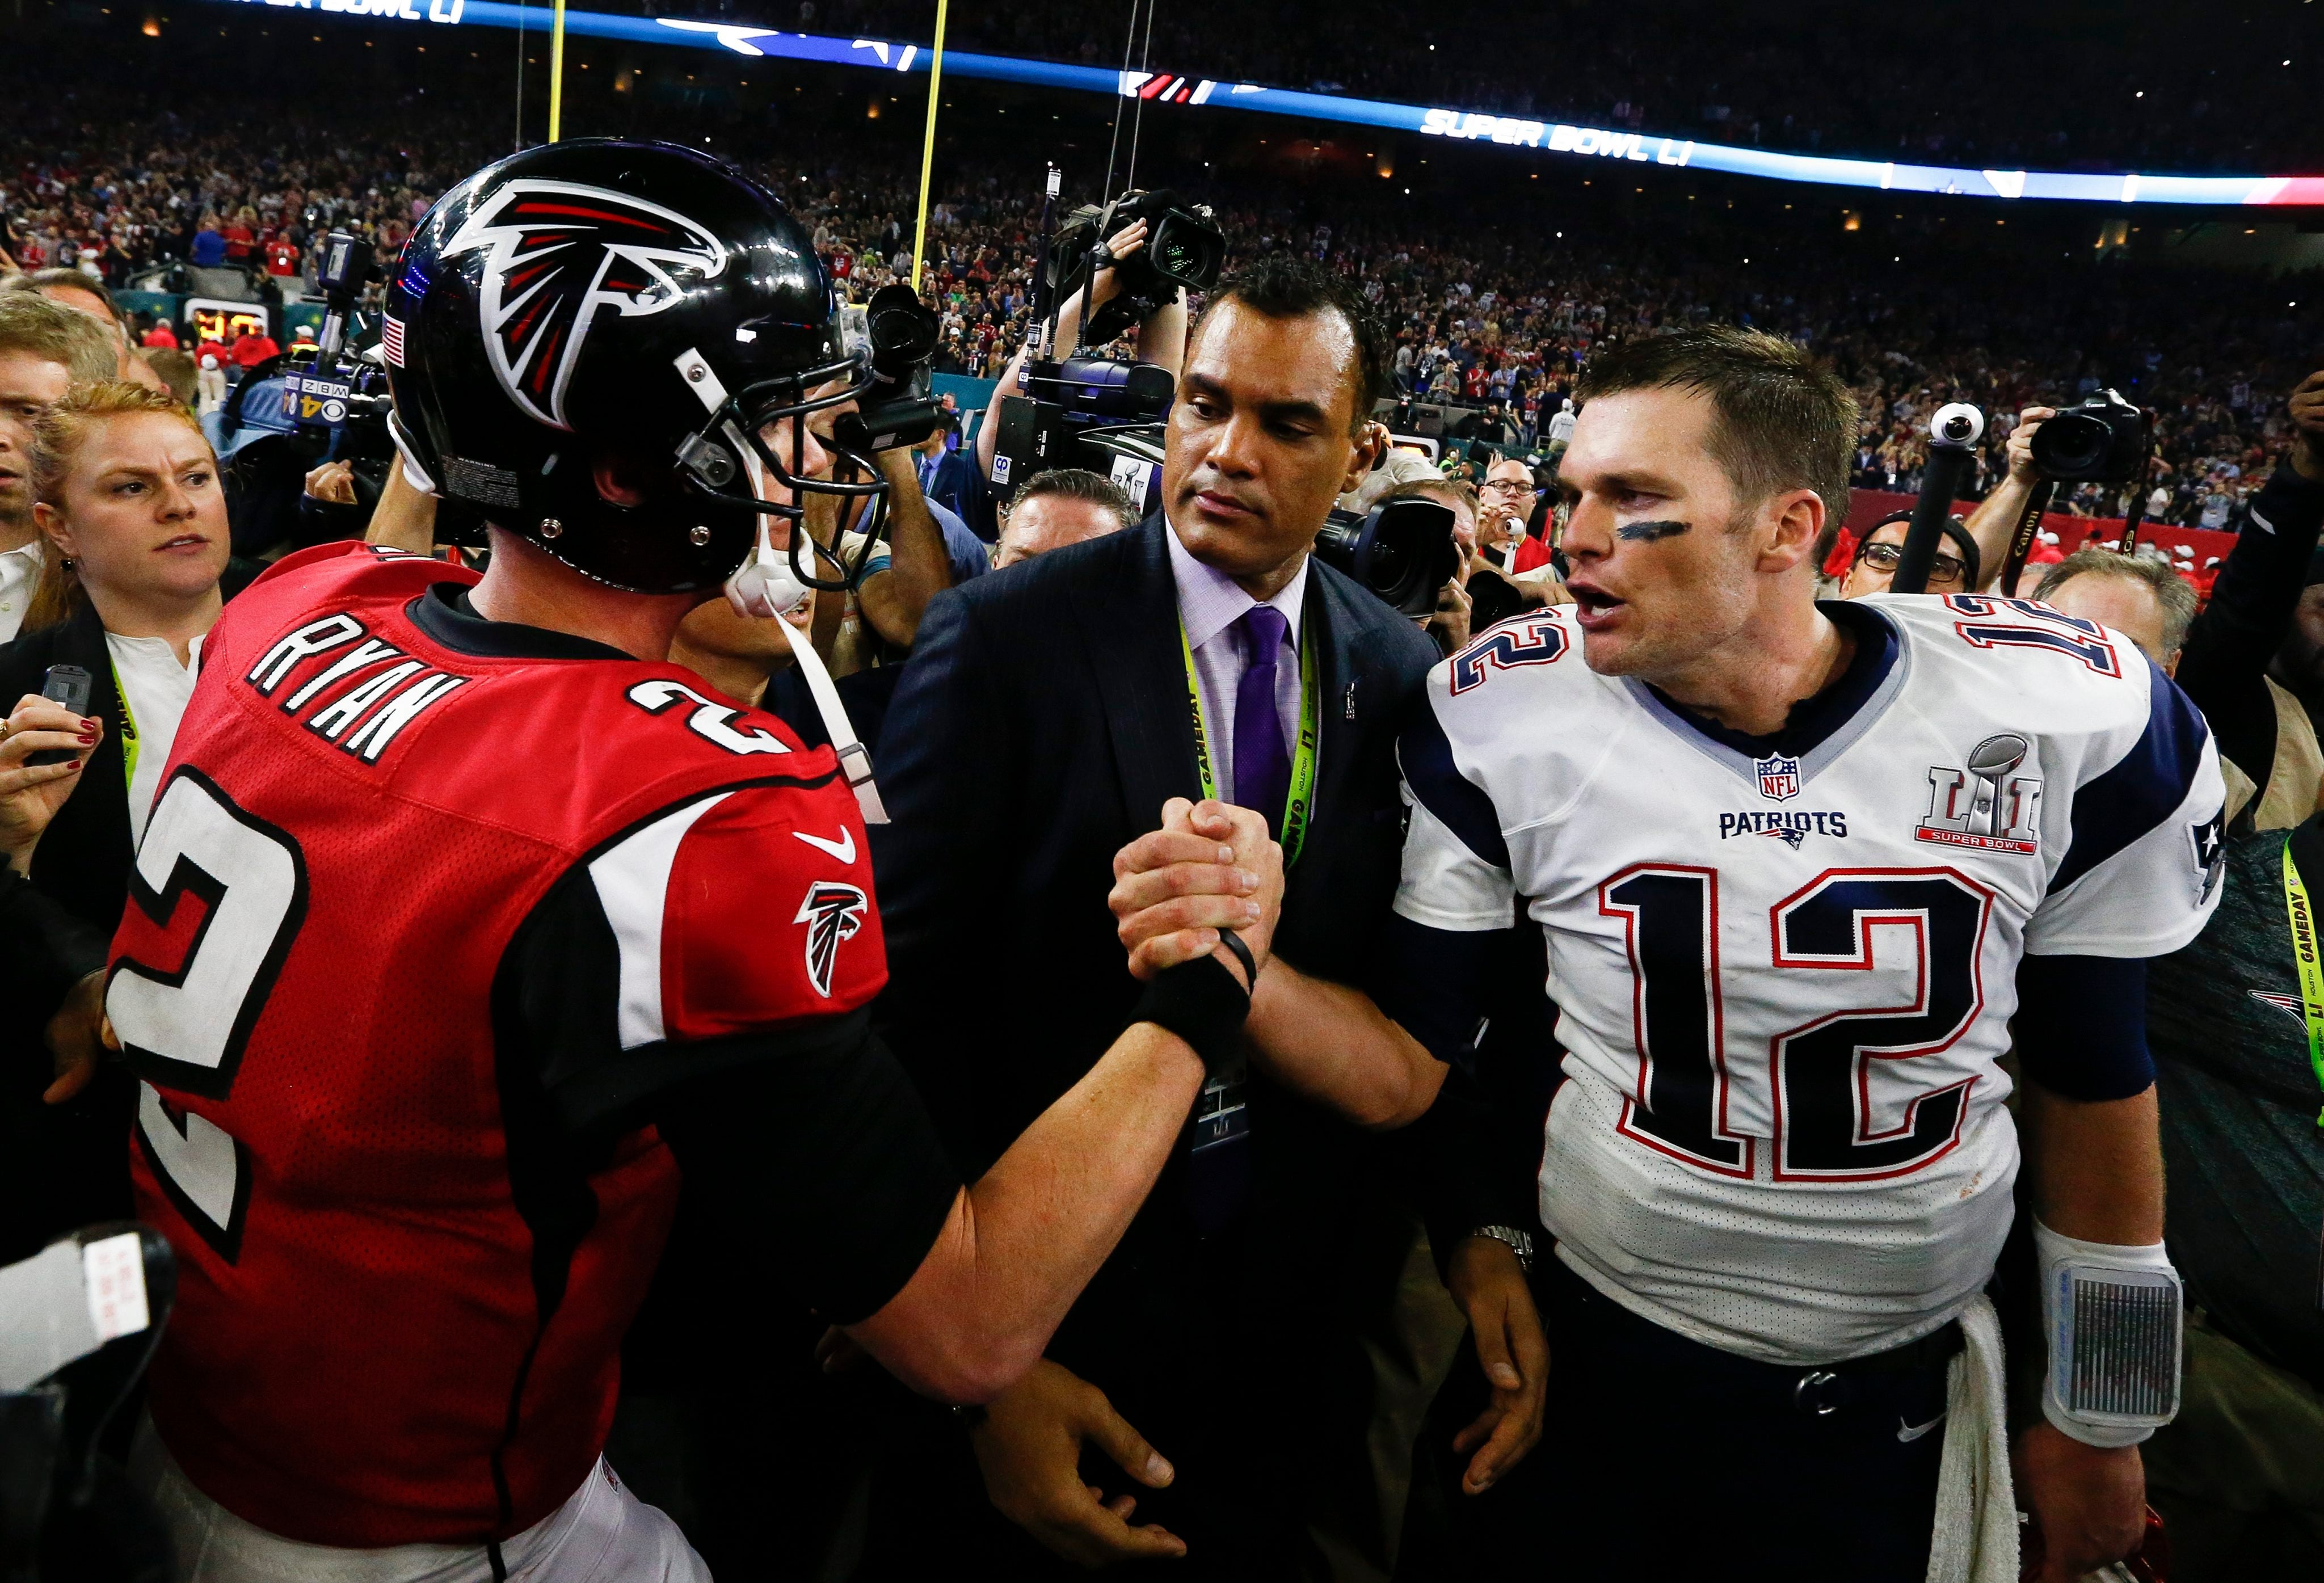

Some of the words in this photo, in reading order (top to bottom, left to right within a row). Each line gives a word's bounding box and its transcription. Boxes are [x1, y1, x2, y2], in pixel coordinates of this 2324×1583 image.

[428, 0, 465, 24] LI
[1420, 108, 1544, 148] SUPER
[1547, 124, 1648, 162] BOWL
[1657, 138, 1695, 167] LI
[300, 394, 323, 418] 4
[304, 381, 348, 397] WBZ
[457, 456, 496, 469] WARNING
[2015, 511, 2039, 557] Canon
[1450, 607, 1570, 697] 12
[1941, 592, 2122, 679] 12
[244, 612, 473, 766] RYAN
[625, 679, 794, 756] 2
[1302, 729, 1313, 750] LI
[1299, 757, 1307, 792] HOUSTON
[1762, 775, 1796, 797] NFL
[1923, 766, 2043, 840] LI
[1719, 812, 1847, 839] PATRIOTS
[1932, 831, 1980, 846] SUPER
[1986, 838, 2021, 851] BOWL
[2290, 891, 2315, 963] GAMEDAY
[105, 764, 309, 1266] 2
[1599, 863, 1994, 1182] 12
[2308, 1003, 2324, 1019] LI
